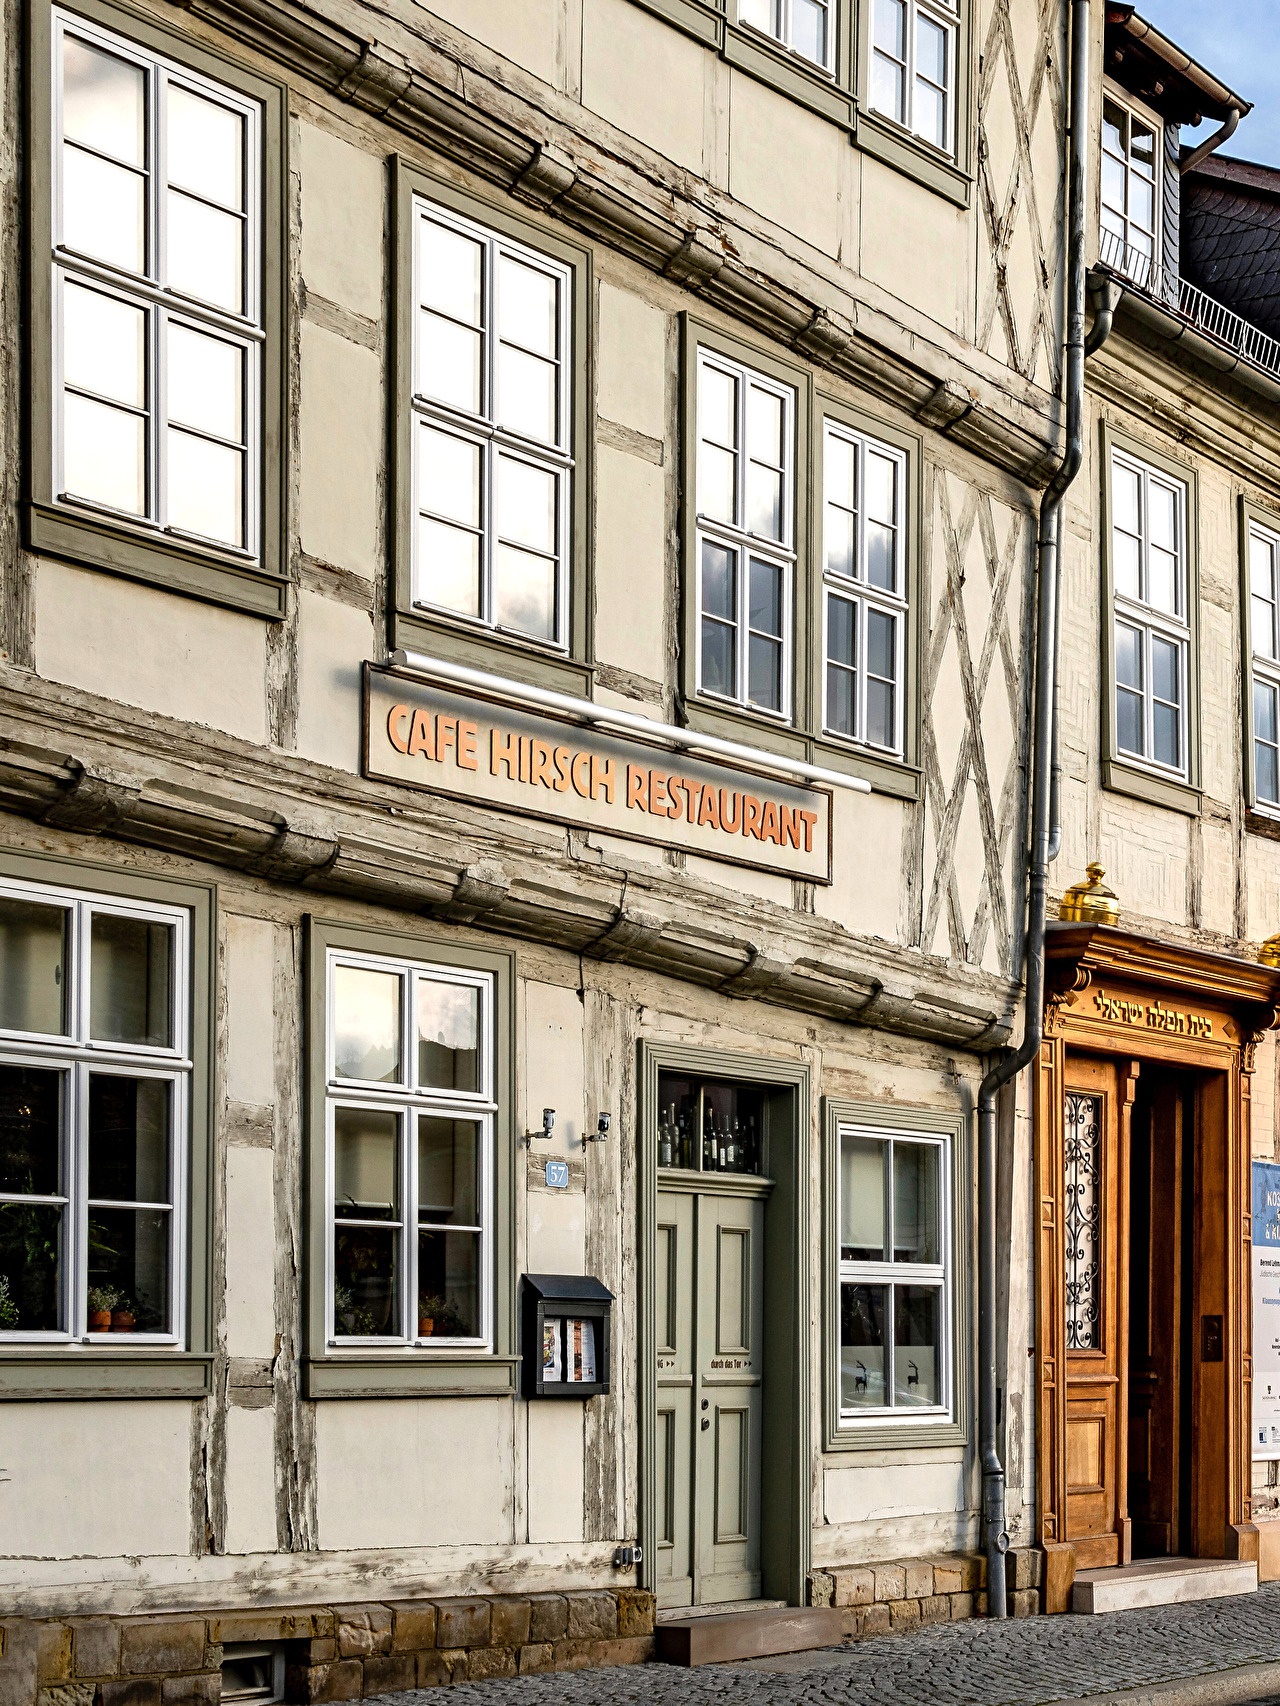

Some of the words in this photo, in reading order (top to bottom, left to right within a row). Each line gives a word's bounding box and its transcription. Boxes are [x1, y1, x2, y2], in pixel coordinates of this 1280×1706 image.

[387, 704, 479, 771] CAFE
[490, 728, 616, 804] HIRSCH
[626, 764, 817, 852] RESTAURANT
[1187, 1014, 1213, 1038] בית
[550, 1165, 566, 1183] 57
[710, 1359, 724, 1369] durch
[725, 1359, 733, 1369] das
[734, 1359, 742, 1369] Tor
